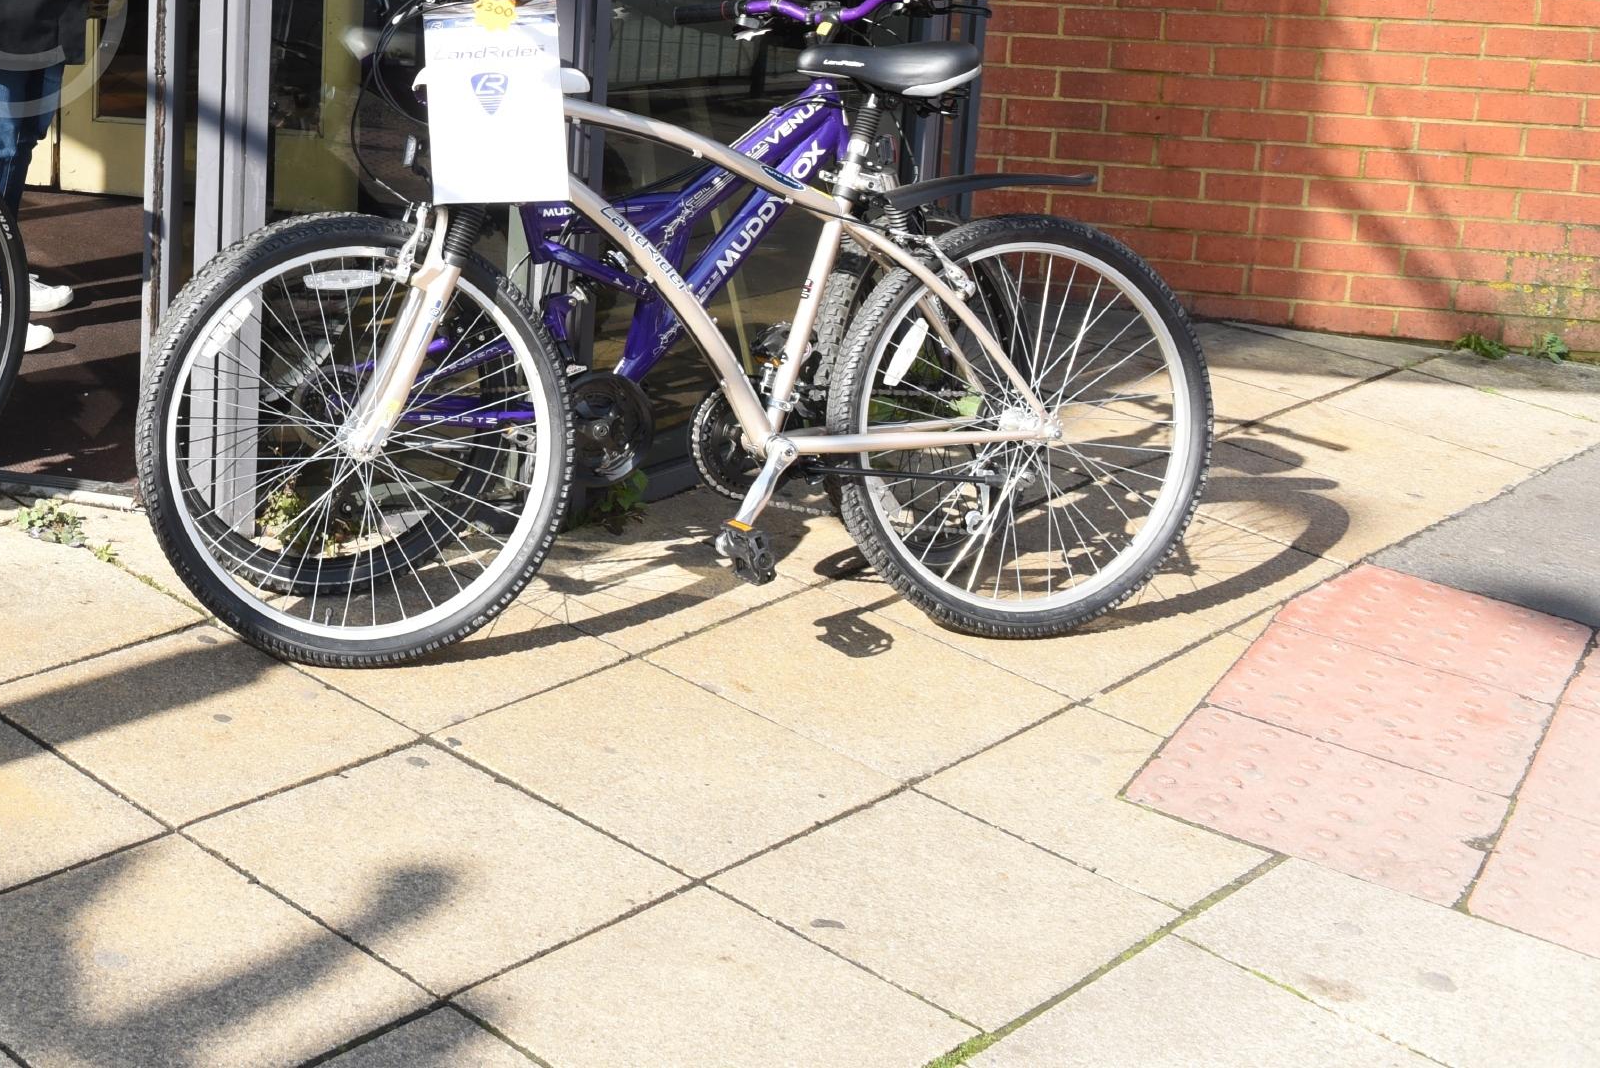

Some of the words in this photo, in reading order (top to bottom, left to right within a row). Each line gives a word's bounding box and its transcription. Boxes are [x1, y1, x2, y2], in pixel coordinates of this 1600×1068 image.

[433, 43, 546, 61] LandRider
[766, 95, 827, 145] VENUS
[601, 205, 692, 294] LandRider
[419, 414, 498, 424] SPORTZ
